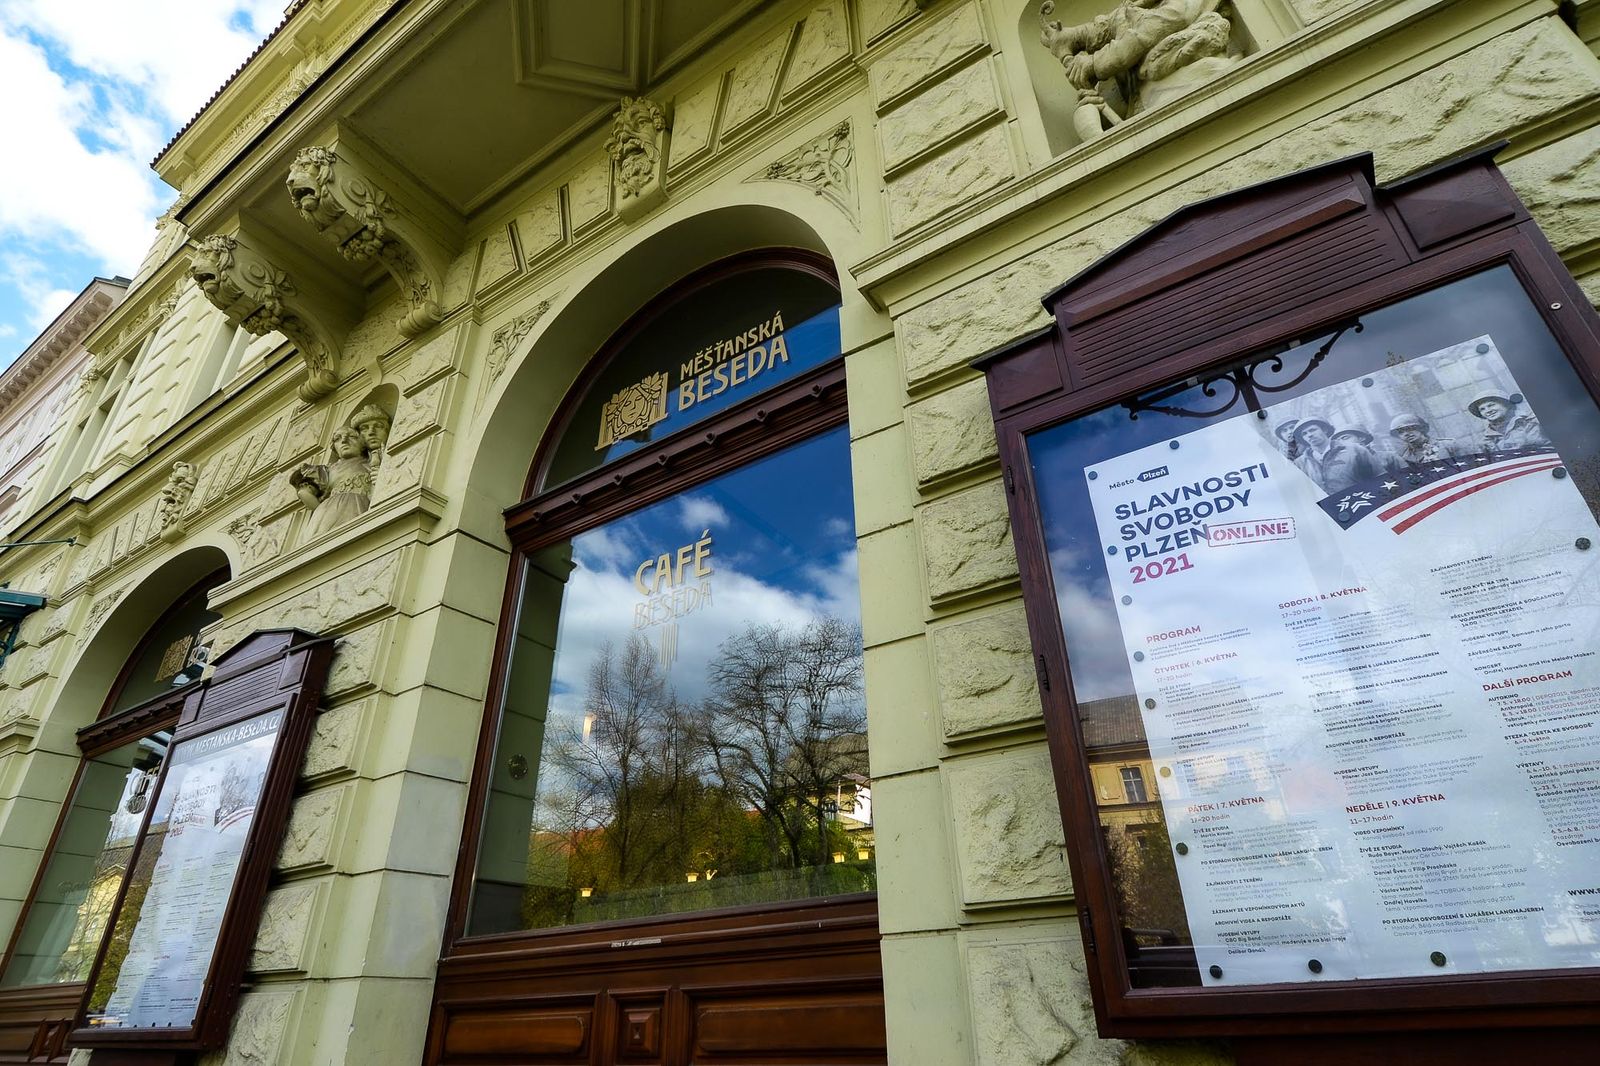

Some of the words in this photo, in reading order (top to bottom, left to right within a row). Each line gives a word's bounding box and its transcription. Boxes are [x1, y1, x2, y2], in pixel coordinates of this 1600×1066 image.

[680, 310, 785, 381] MĚŠŤANSKÁ
[678, 334, 789, 411] BESEDA
[1109, 478, 1135, 490] Město
[1141, 467, 1167, 481] Plzeň
[1114, 462, 1270, 520] SLAVNOSTI
[1120, 489, 1252, 541] SVOBODY
[1212, 522, 1289, 541] ONLINE
[1125, 520, 1211, 562] PLZEŇ
[635, 529, 712, 596] CAFÉ
[1129, 553, 1194, 584] 2021
[633, 581, 713, 630] BESEDA
[1278, 597, 1313, 609] SOBOTA
[1330, 586, 1368, 598] KVĚTNA
[1303, 605, 1322, 615] hodin
[1459, 611, 1498, 622] VOJENSKÝCH
[1498, 606, 1523, 614] LETADEL
[1475, 602, 1517, 614] HISTORICKÝCH
[1146, 625, 1202, 643] PROGRAM
[1328, 647, 1360, 656] OSVOBOZENÍ
[1398, 652, 1440, 662] LANGMAJEREM
[1468, 647, 1501, 656] ZÁVĚREČNÉ
[1154, 663, 1190, 674] ČTVRTEK
[1204, 651, 1238, 664] KVĚTNA
[1474, 663, 1501, 671] KONCERT
[1406, 671, 1448, 681] LANGMAJEREM
[1483, 678, 1515, 691] DALŠÍ
[1516, 670, 1573, 686] PROGRAM
[1488, 694, 1519, 702] AUTOKINO
[1349, 715, 1375, 723] historická
[1326, 724, 1356, 732] samostatné
[1374, 732, 1405, 740] REPORTÁŽE
[1188, 802, 1217, 813] PÁTEK
[1220, 801, 1228, 809] 7.
[1230, 796, 1265, 807] KVĚTNA
[1346, 803, 1384, 813] NEDĚLE
[1402, 793, 1446, 806] KVĚTNA
[1212, 813, 1230, 821] hodin
[1350, 817, 1371, 825] 11–17
[1372, 813, 1394, 822] hodin
[1427, 863, 1457, 871] Procházka
[1245, 903, 1289, 911] VZPOMÍNKOVÝCH
[1496, 907, 1545, 915] LANGMAJEREM
